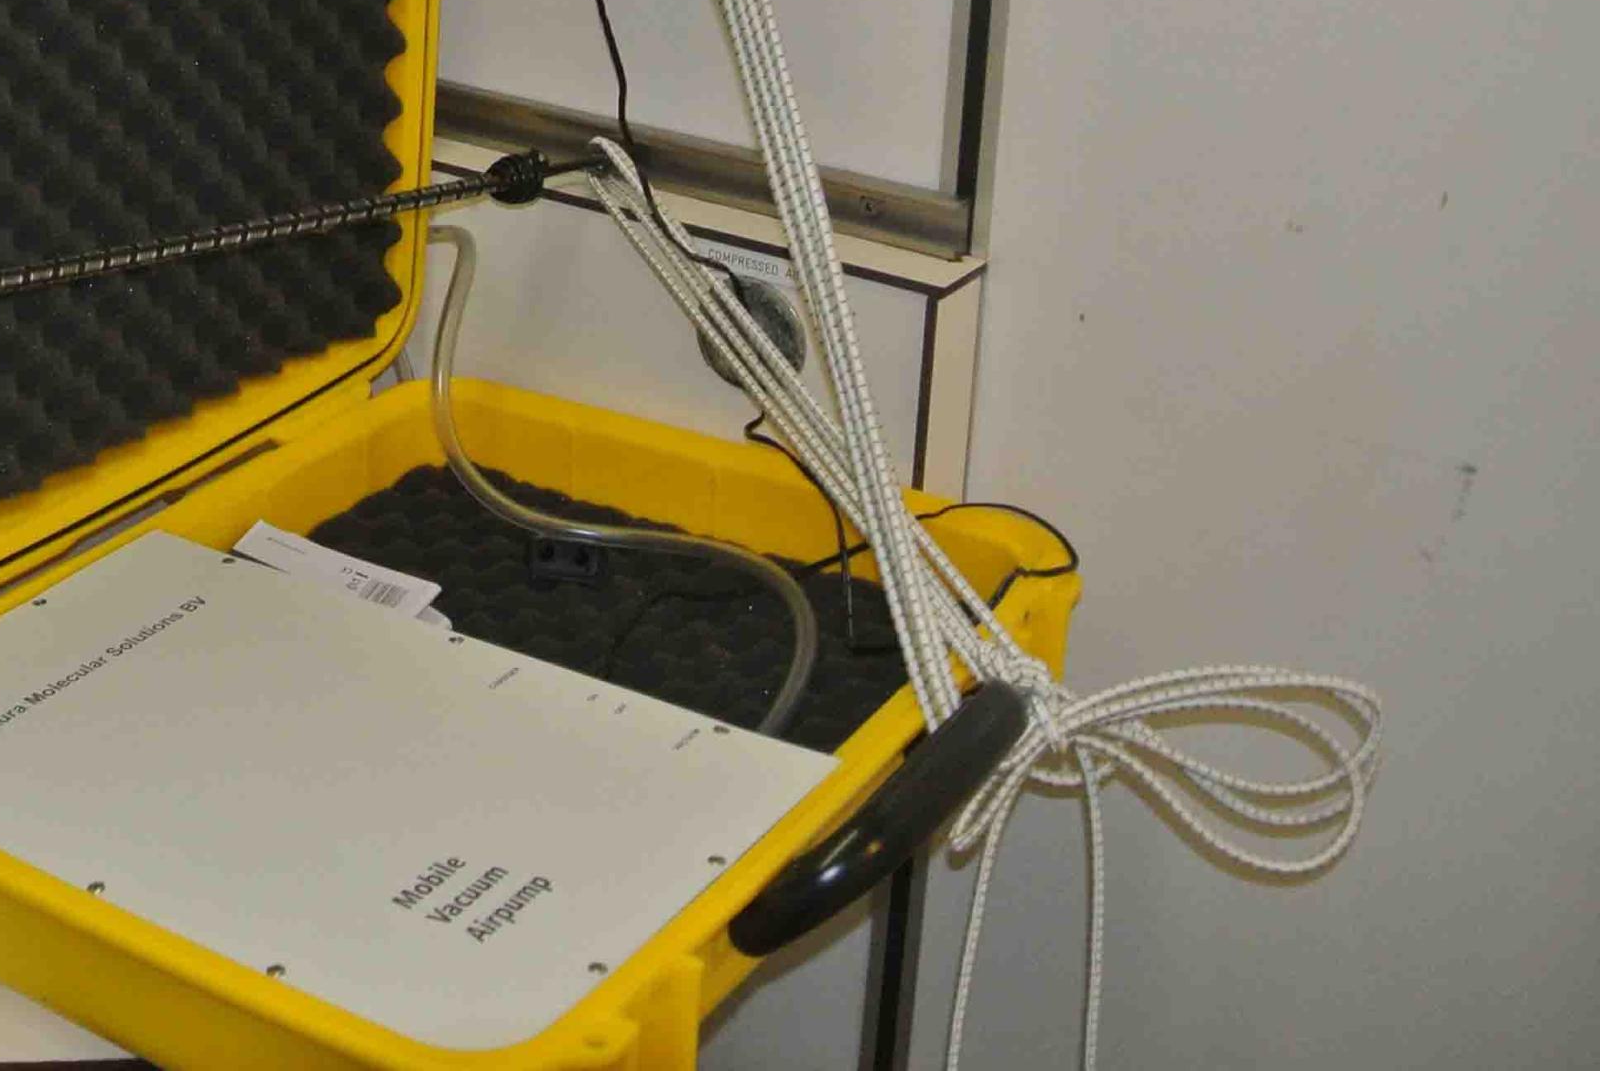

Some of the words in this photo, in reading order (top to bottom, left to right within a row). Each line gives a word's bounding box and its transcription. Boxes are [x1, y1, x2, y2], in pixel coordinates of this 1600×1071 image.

[708, 248, 779, 277] COMPRESSED
[23, 656, 108, 706] Molecular
[106, 611, 184, 657] Solutions
[180, 595, 206, 612] BV
[392, 856, 466, 910] Mobile
[426, 865, 509, 924] Vacuum
[466, 875, 553, 943] Airpump
